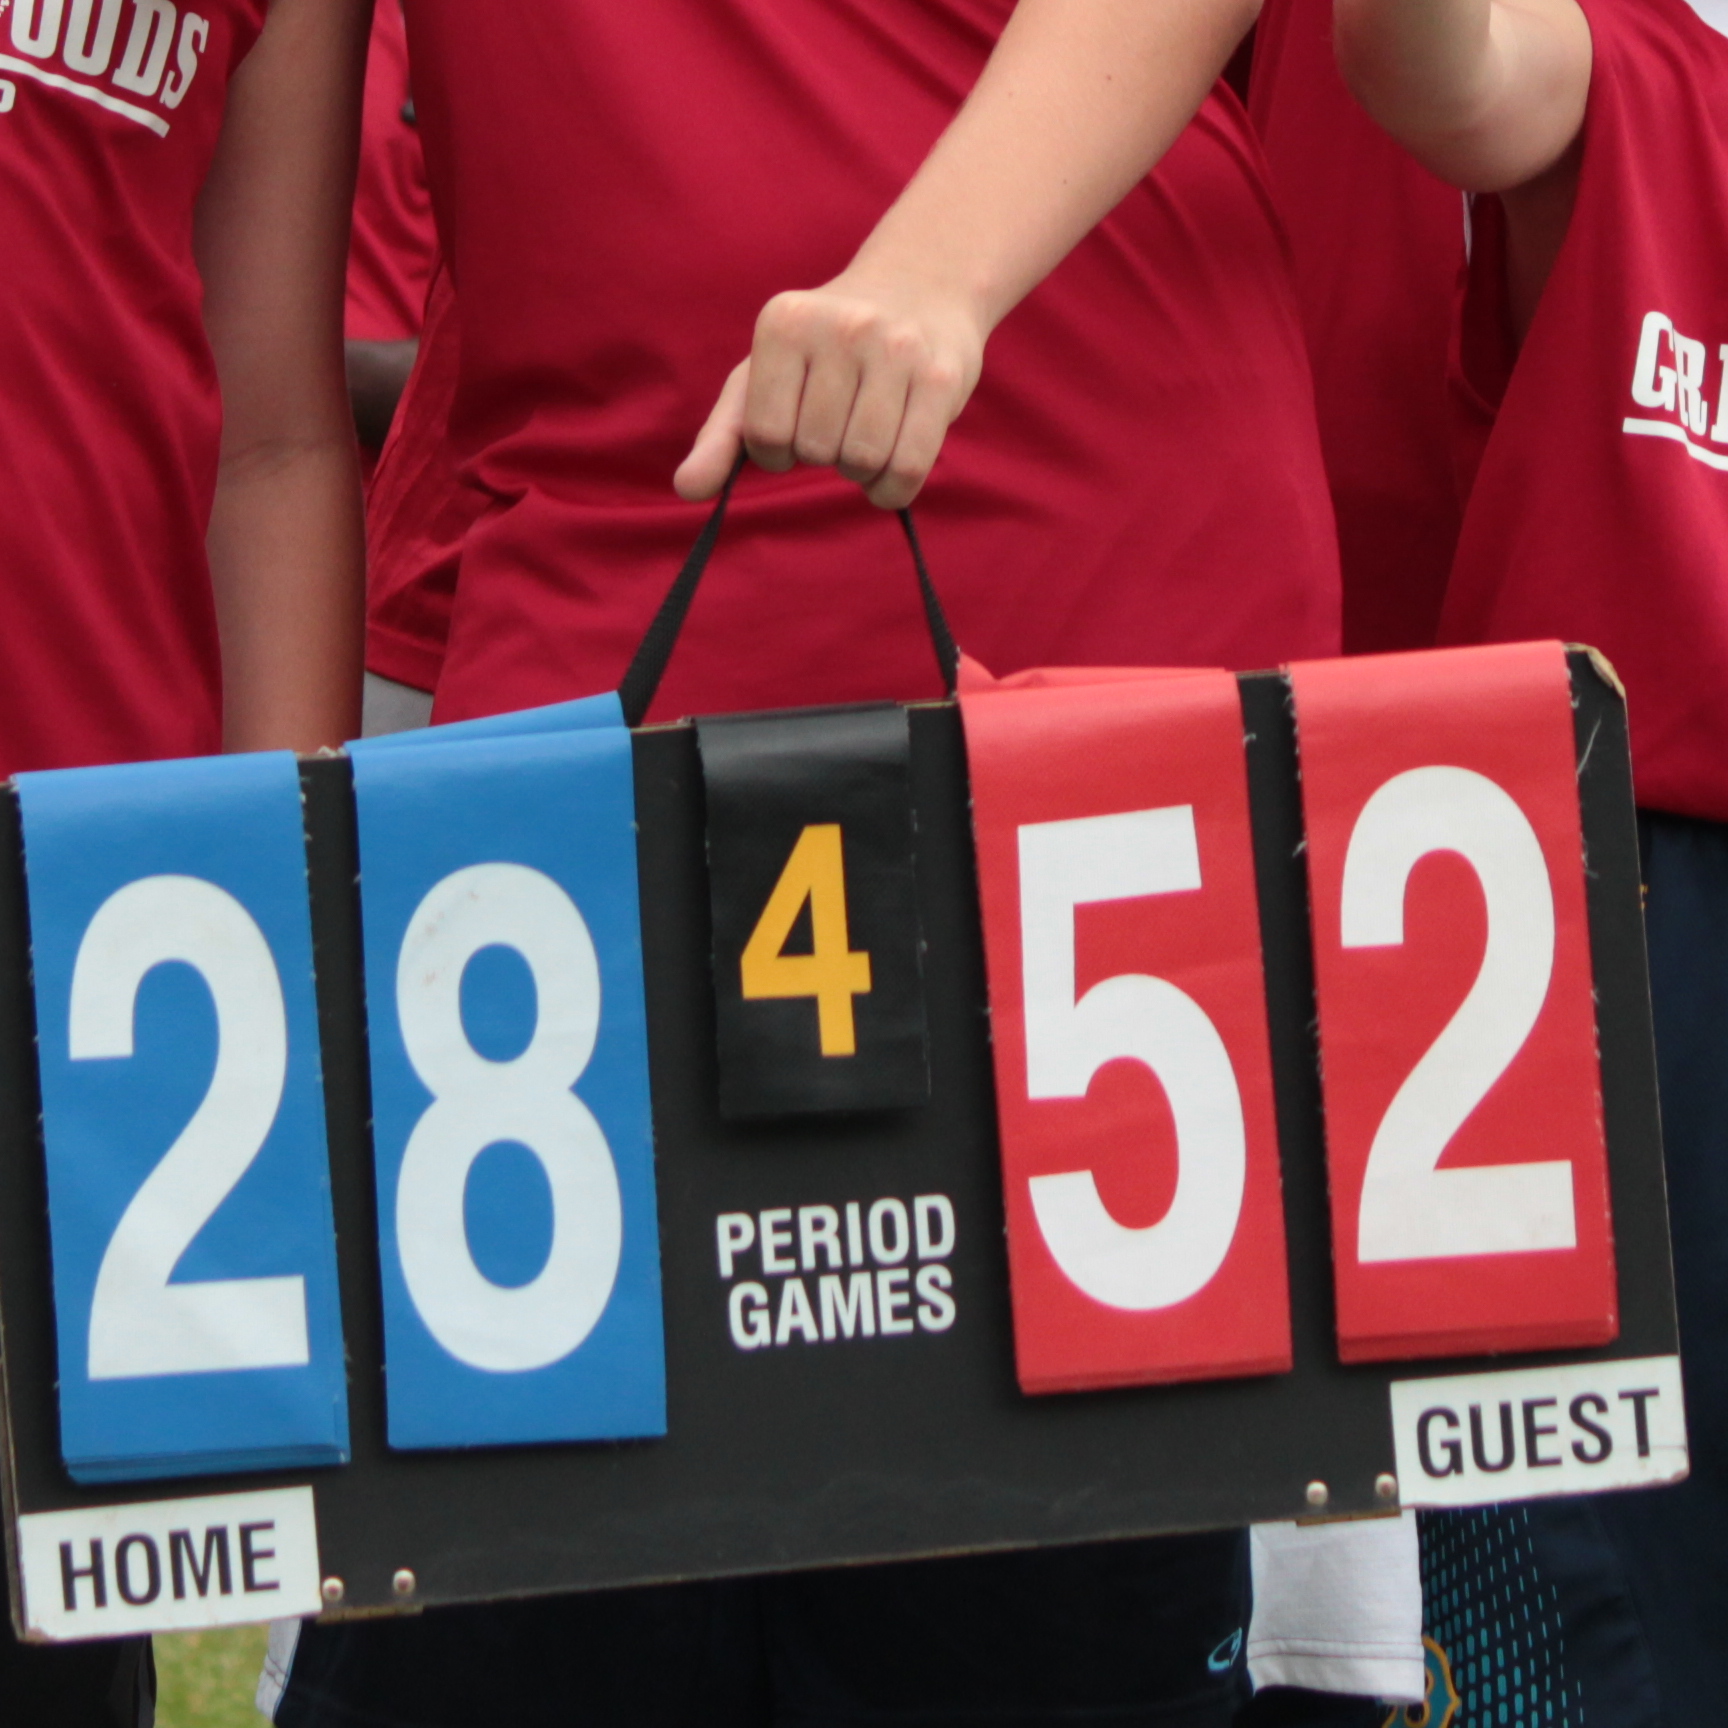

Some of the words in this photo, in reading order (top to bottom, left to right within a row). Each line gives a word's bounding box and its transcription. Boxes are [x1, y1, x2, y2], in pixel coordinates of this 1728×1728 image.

[739, 823, 872, 1058] 4
[716, 1192, 957, 1280] PERIOD
[728, 1263, 957, 1351] GAMES
[1414, 1387, 1661, 1477] GUEST
[58, 1522, 281, 1611] HOME
